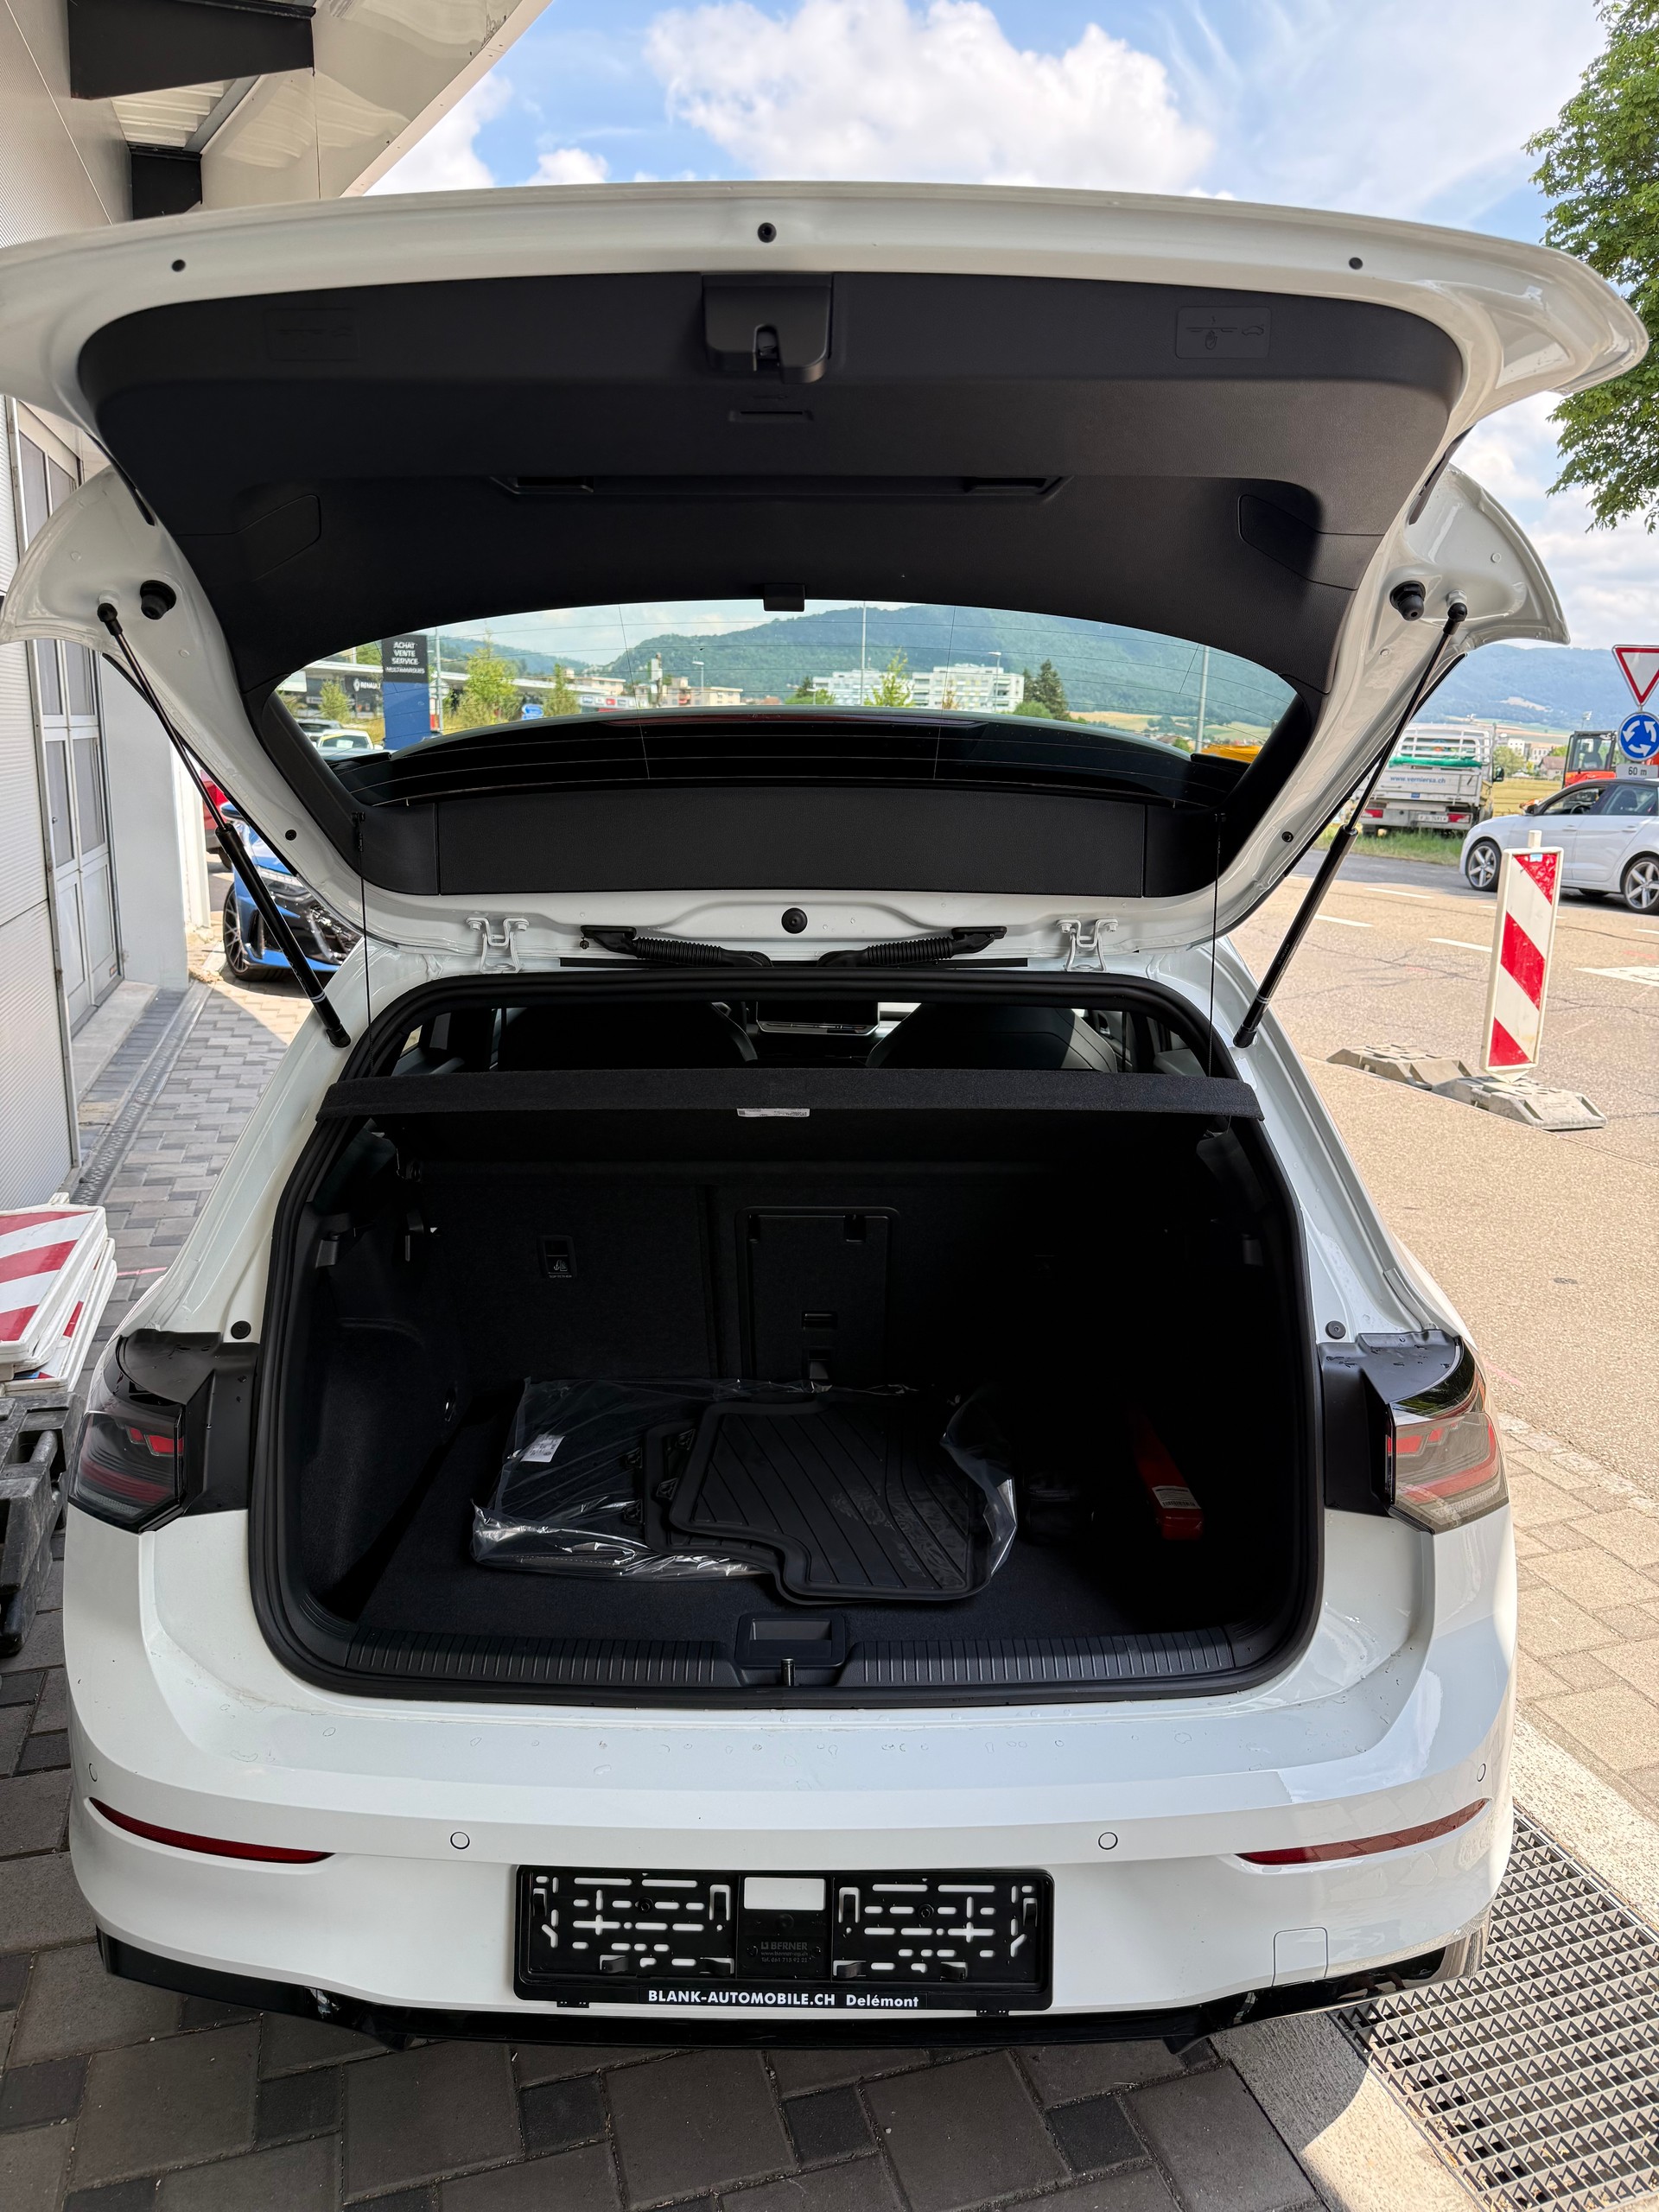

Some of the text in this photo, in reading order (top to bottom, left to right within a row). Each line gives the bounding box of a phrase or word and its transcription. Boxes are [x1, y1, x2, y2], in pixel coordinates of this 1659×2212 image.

[391, 657, 419, 665] SERVICE
[1628, 766, 1638, 776] 60
[771, 1942, 808, 1950] BERNER
[648, 1990, 919, 2007] BLANK-AUTOMOBILE.CH Delémont
